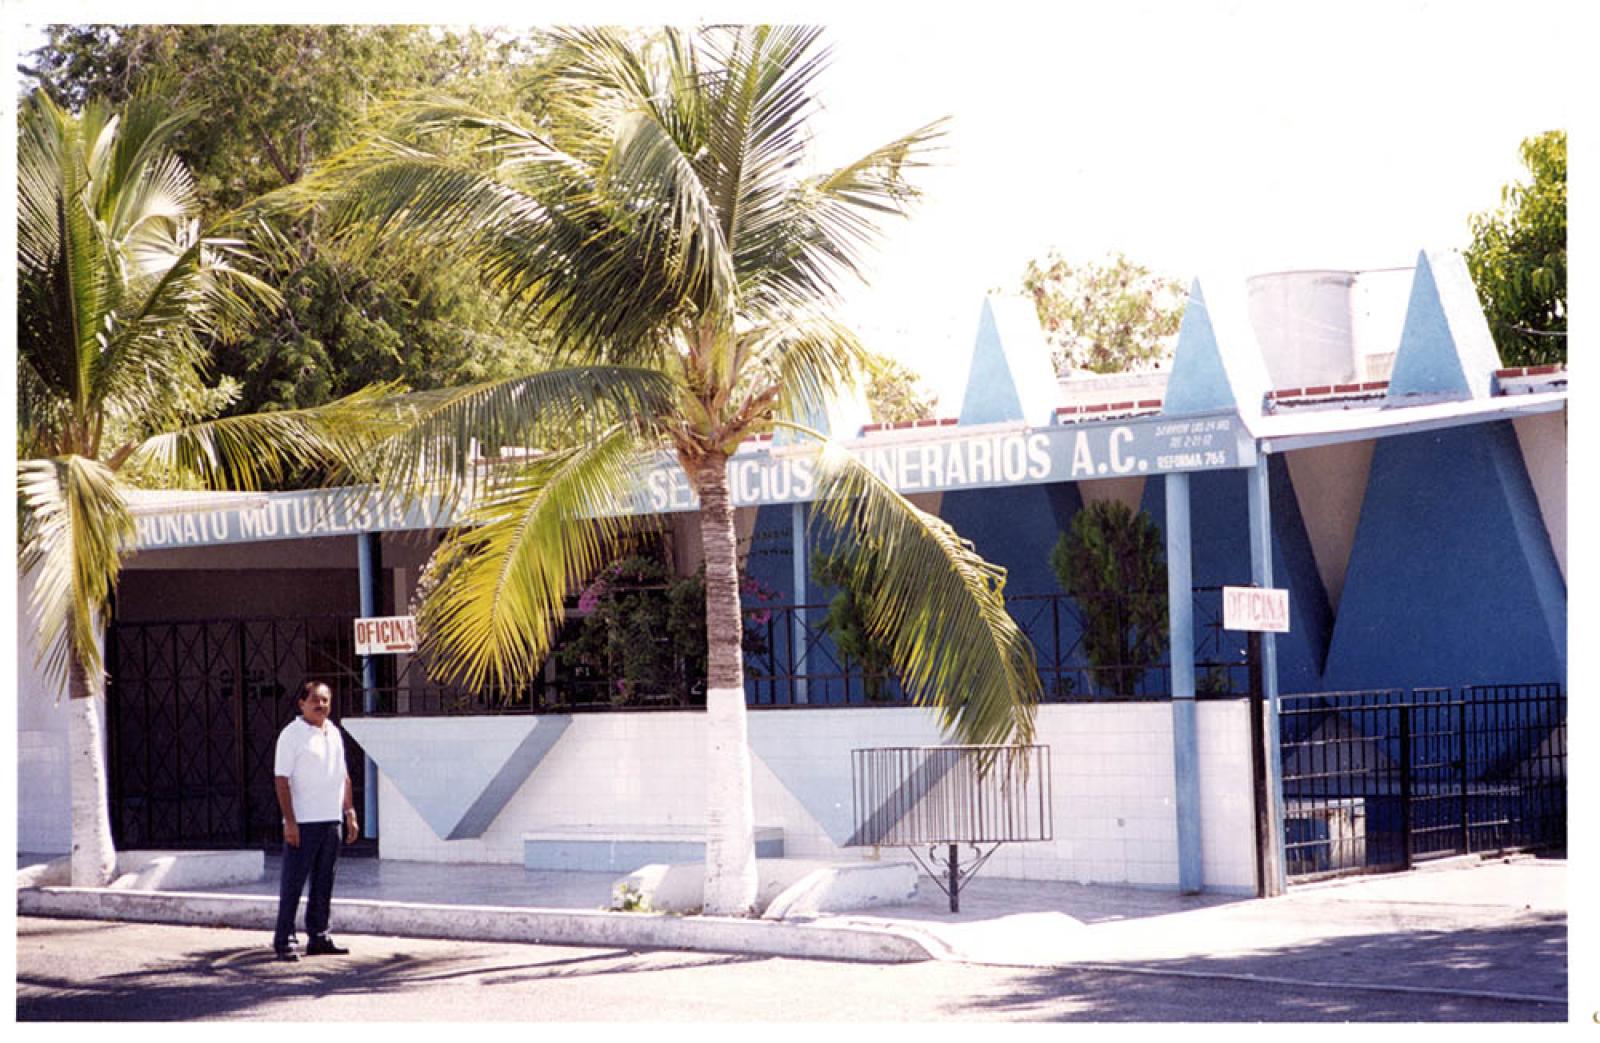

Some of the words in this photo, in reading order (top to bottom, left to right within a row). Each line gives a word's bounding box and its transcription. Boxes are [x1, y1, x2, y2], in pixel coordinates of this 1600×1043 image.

[648, 458, 814, 509] SEICIOS
[1072, 427, 1149, 476] A.C.
[1156, 453, 1202, 469] REFORMA
[1226, 591, 1287, 624] OFICINA
[356, 619, 416, 645] OFICINA
